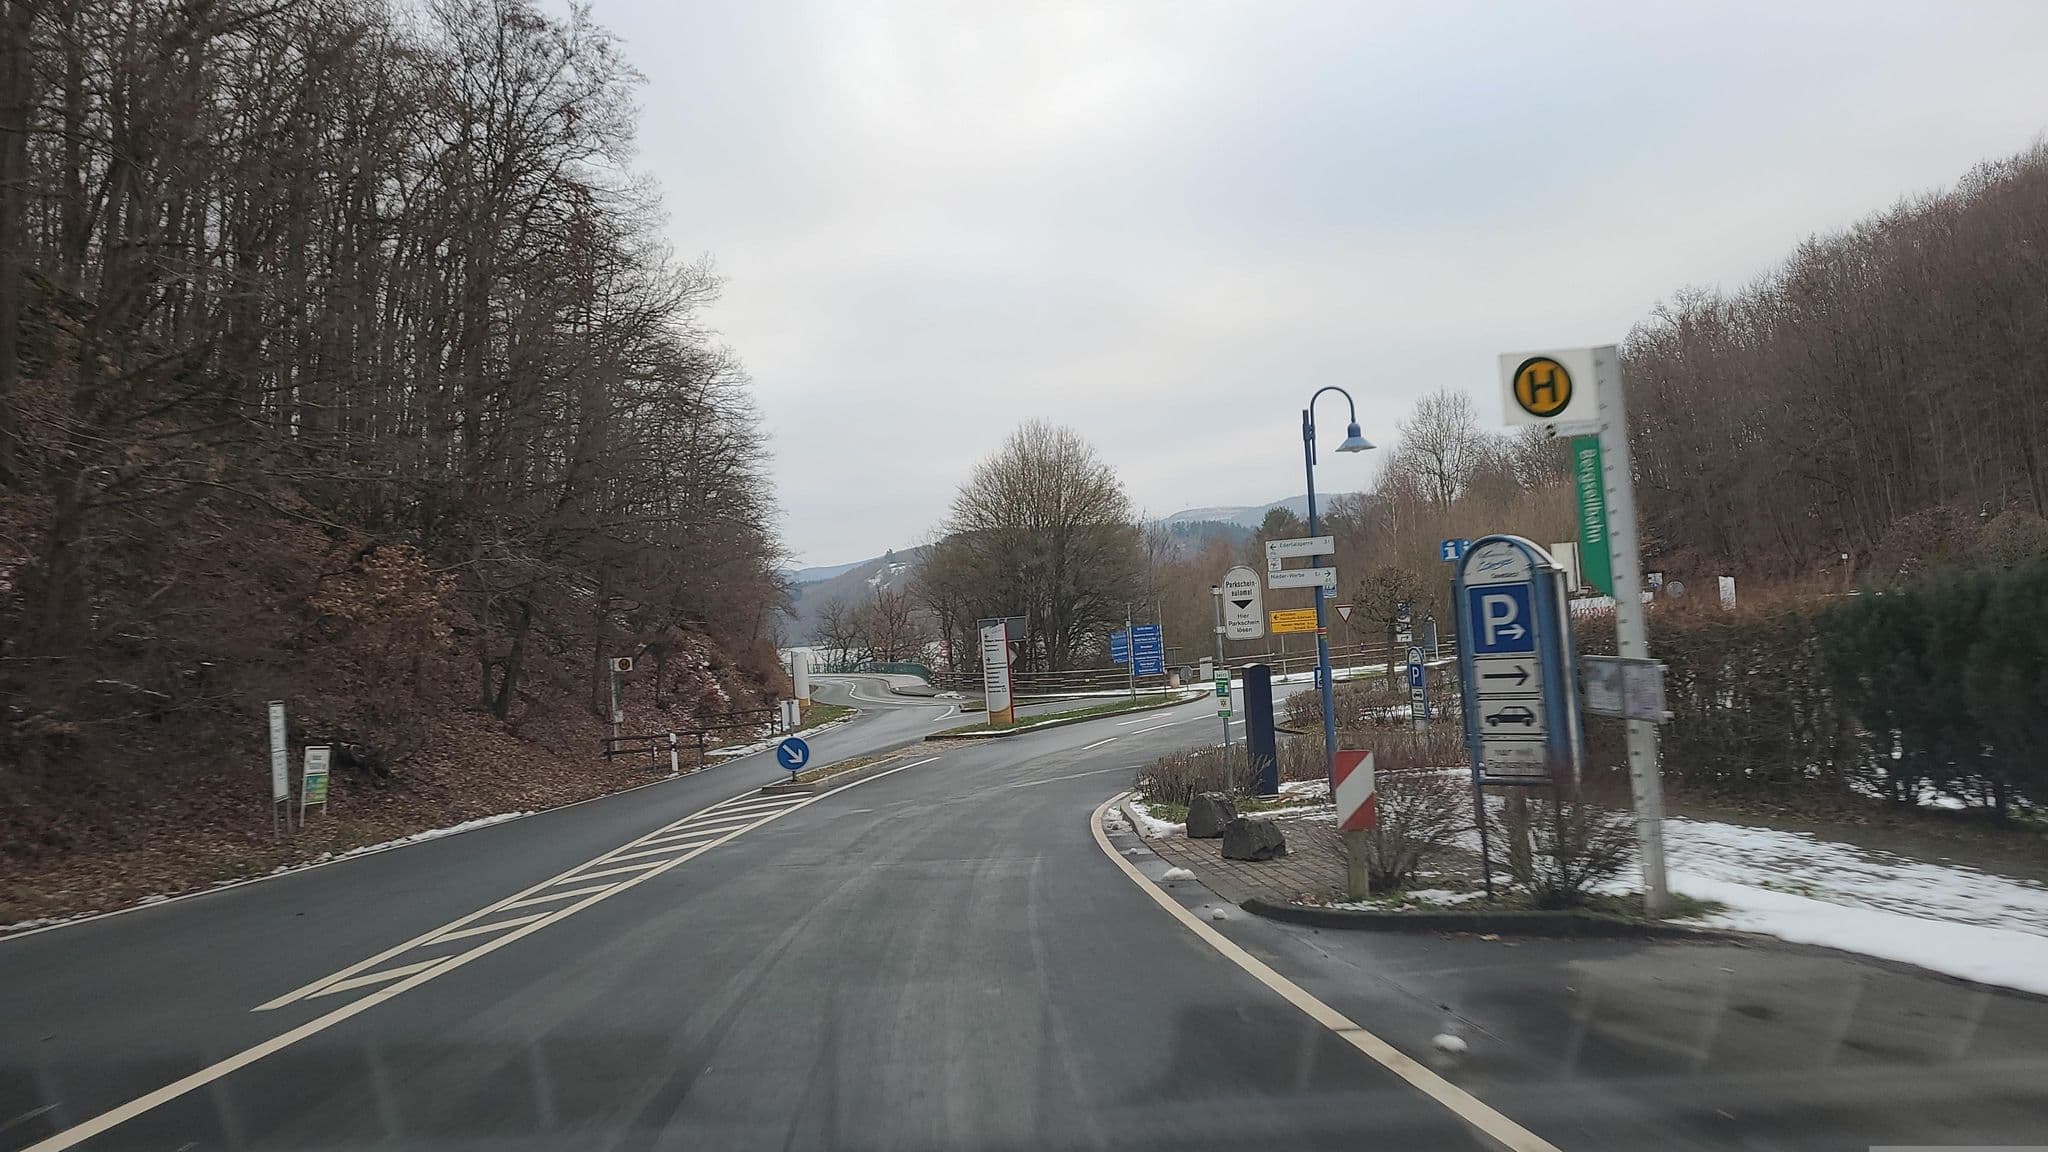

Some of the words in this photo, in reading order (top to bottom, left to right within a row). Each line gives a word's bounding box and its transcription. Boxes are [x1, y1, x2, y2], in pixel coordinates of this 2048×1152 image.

[1529, 369, 1558, 404] H
[1482, 594, 1519, 646] P
[1412, 666, 1419, 684] P
